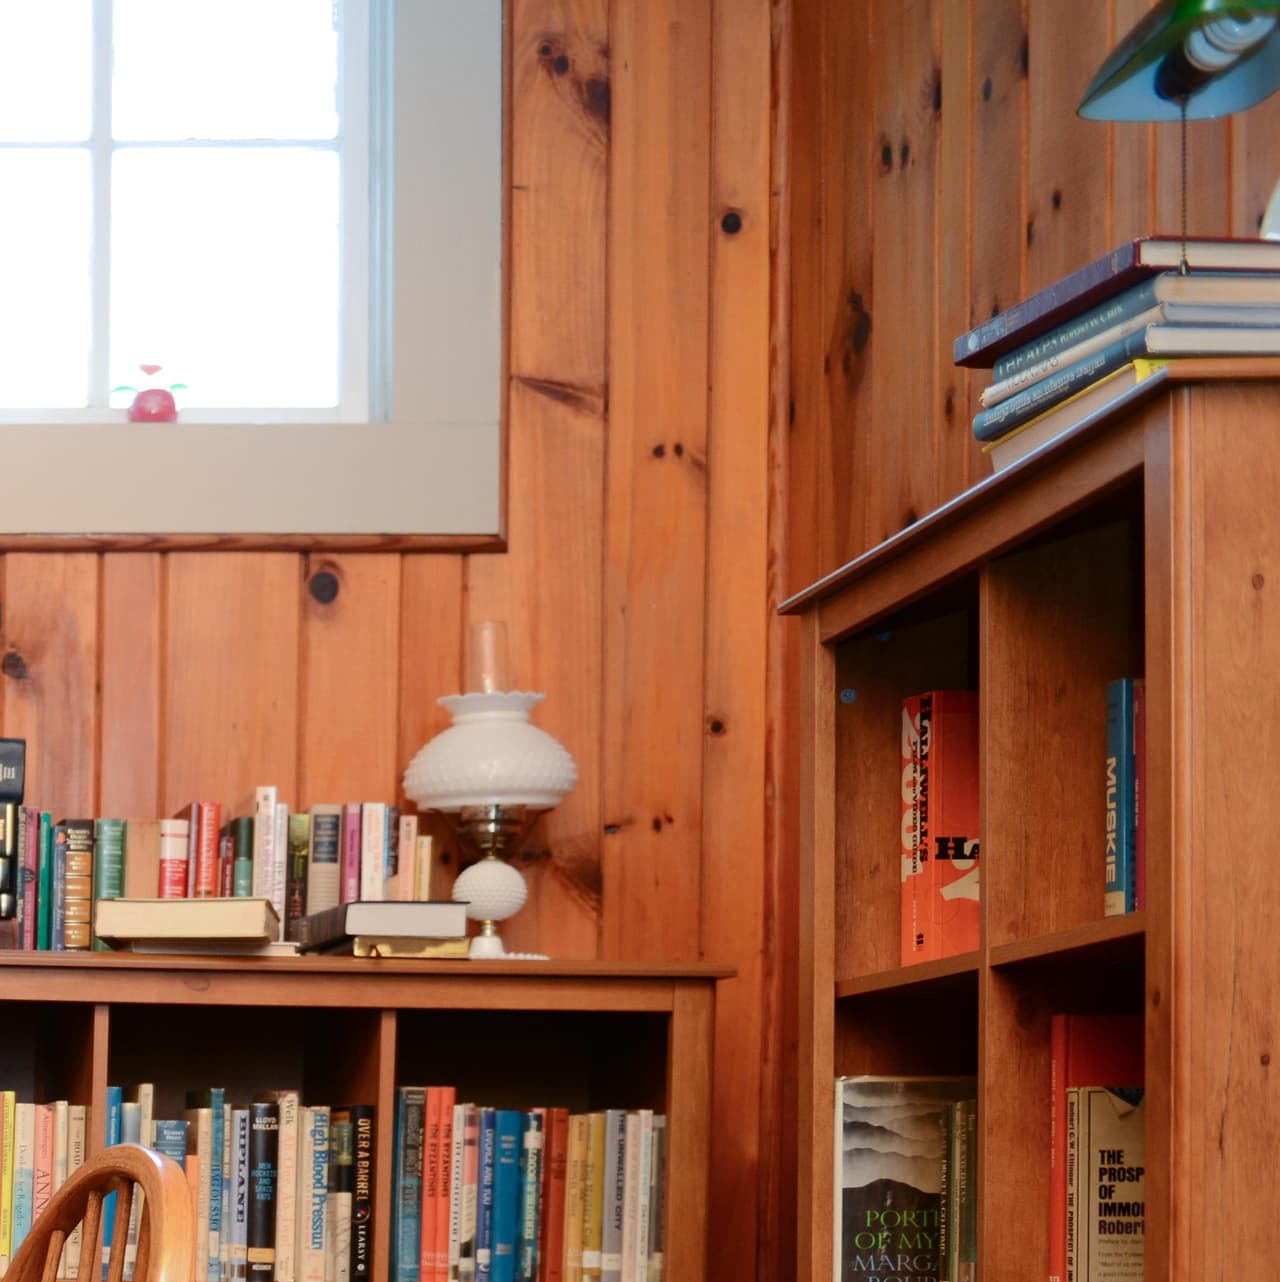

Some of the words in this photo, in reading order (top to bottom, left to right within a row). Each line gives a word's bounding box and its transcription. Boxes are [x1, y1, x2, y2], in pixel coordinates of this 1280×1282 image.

[920, 695, 932, 863] HALLIWELL'S
[1106, 757, 1117, 884] MUSKIE
[284, 1100, 297, 1125] Welk
[617, 1113, 626, 1135] THE
[311, 1112, 329, 1146] High
[357, 1119, 372, 1148] OVER
[357, 1150, 371, 1159] A
[1099, 1150, 1124, 1165] THE
[237, 1115, 248, 1224] BIPLANE
[311, 1149, 328, 1190] Blood
[356, 1160, 370, 1201] BARREL
[482, 1166, 494, 1186] AND
[615, 1138, 626, 1201] UNWALLED
[1099, 1167, 1144, 1182] PROSP
[482, 1188, 494, 1206] YOU
[1099, 1185, 1115, 1200] OF
[310, 1193, 327, 1251] Pressur
[614, 1205, 623, 1231] CITY
[865, 1209, 940, 1235] PORT
[357, 1225, 366, 1260] LEARSY
[855, 1232, 891, 1257] OF
